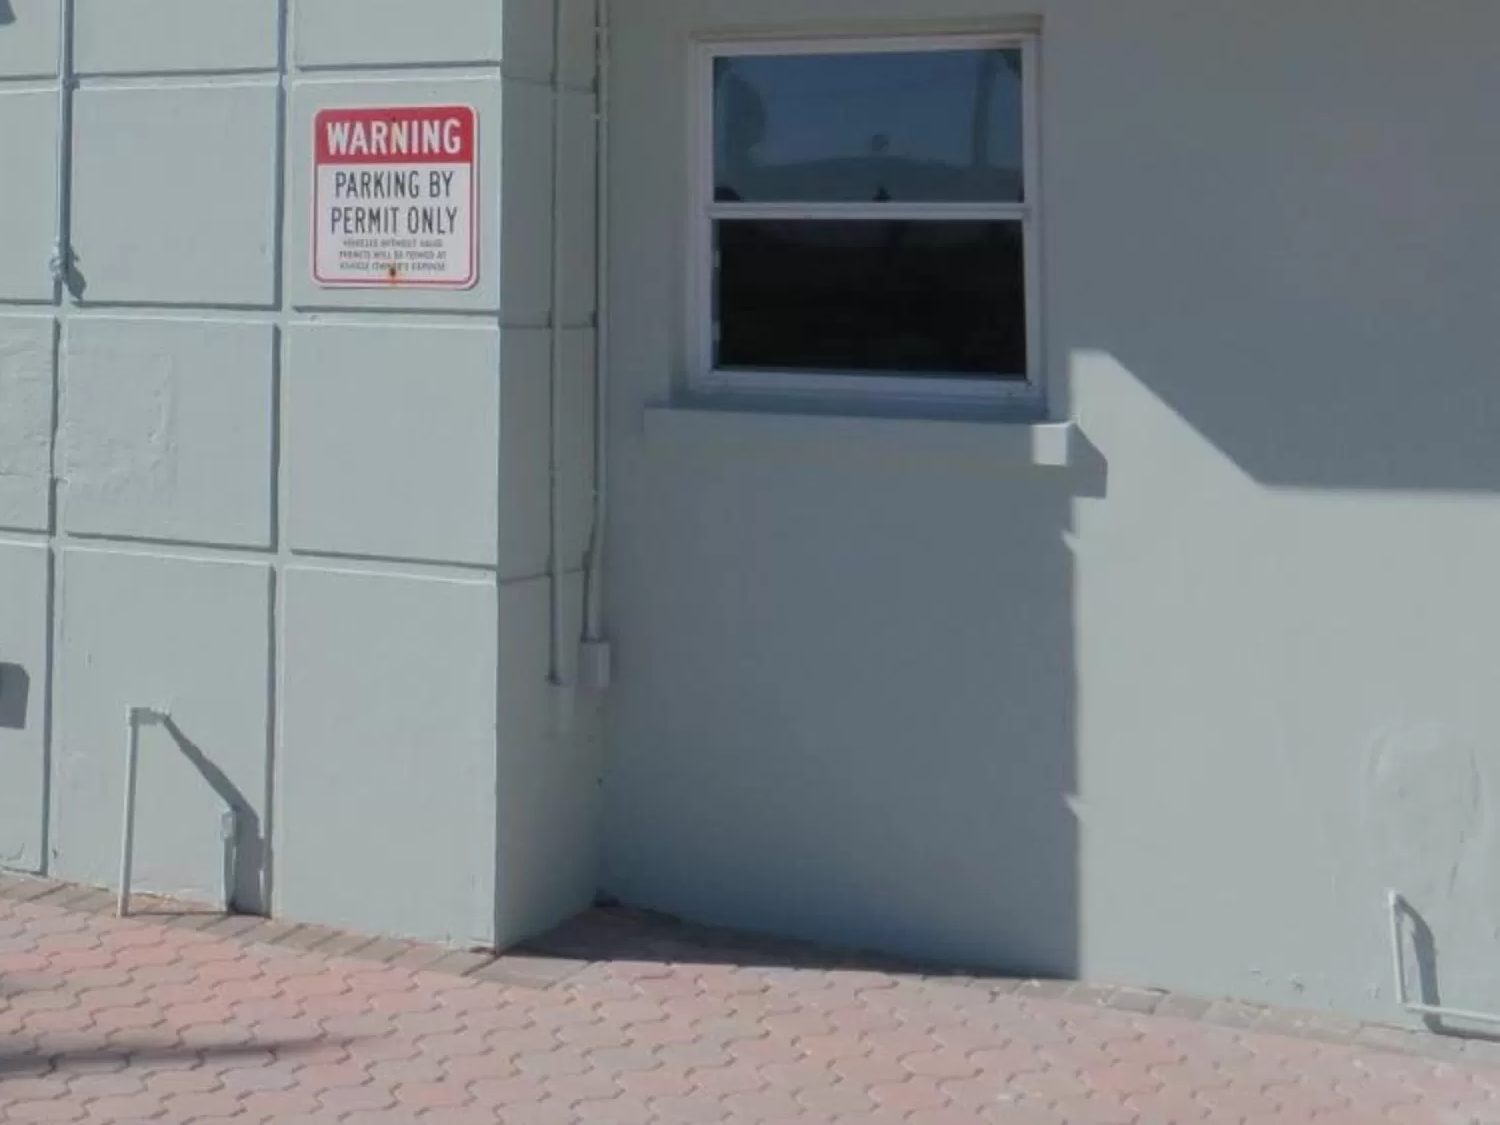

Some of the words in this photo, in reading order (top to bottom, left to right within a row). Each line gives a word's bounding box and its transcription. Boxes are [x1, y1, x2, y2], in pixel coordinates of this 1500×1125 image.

[326, 118, 462, 156] WARNING
[334, 170, 420, 200] PARKING
[428, 170, 455, 198] BY
[330, 206, 400, 236] PERMIT
[407, 206, 459, 235] ONLY
